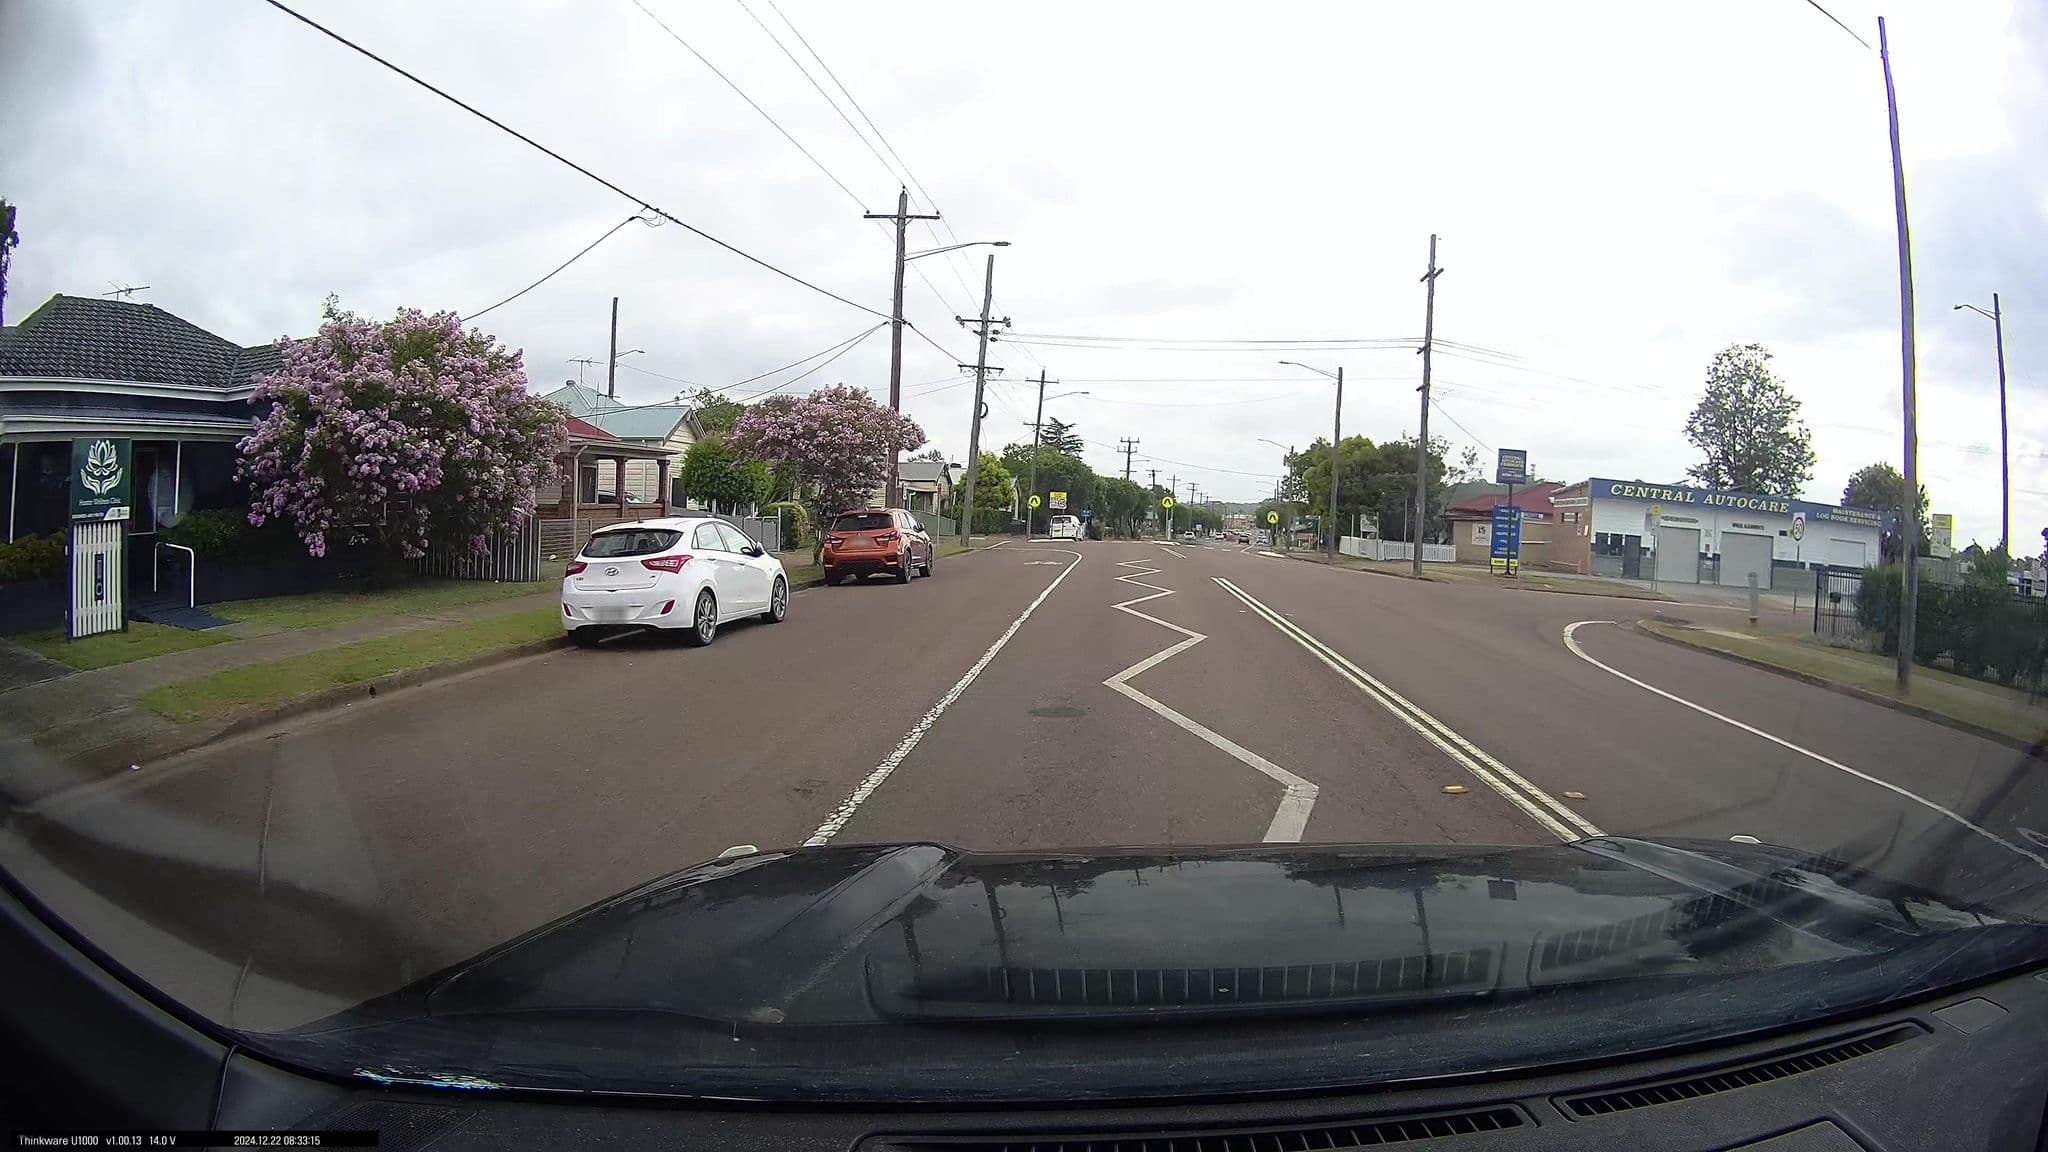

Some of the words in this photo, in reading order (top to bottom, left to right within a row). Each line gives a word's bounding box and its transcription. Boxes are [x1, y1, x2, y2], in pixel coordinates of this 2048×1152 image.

[1611, 484, 1695, 503] CENTRAL
[1703, 494, 1790, 513] AUTOCARE
[1816, 511, 1830, 521] LOG
